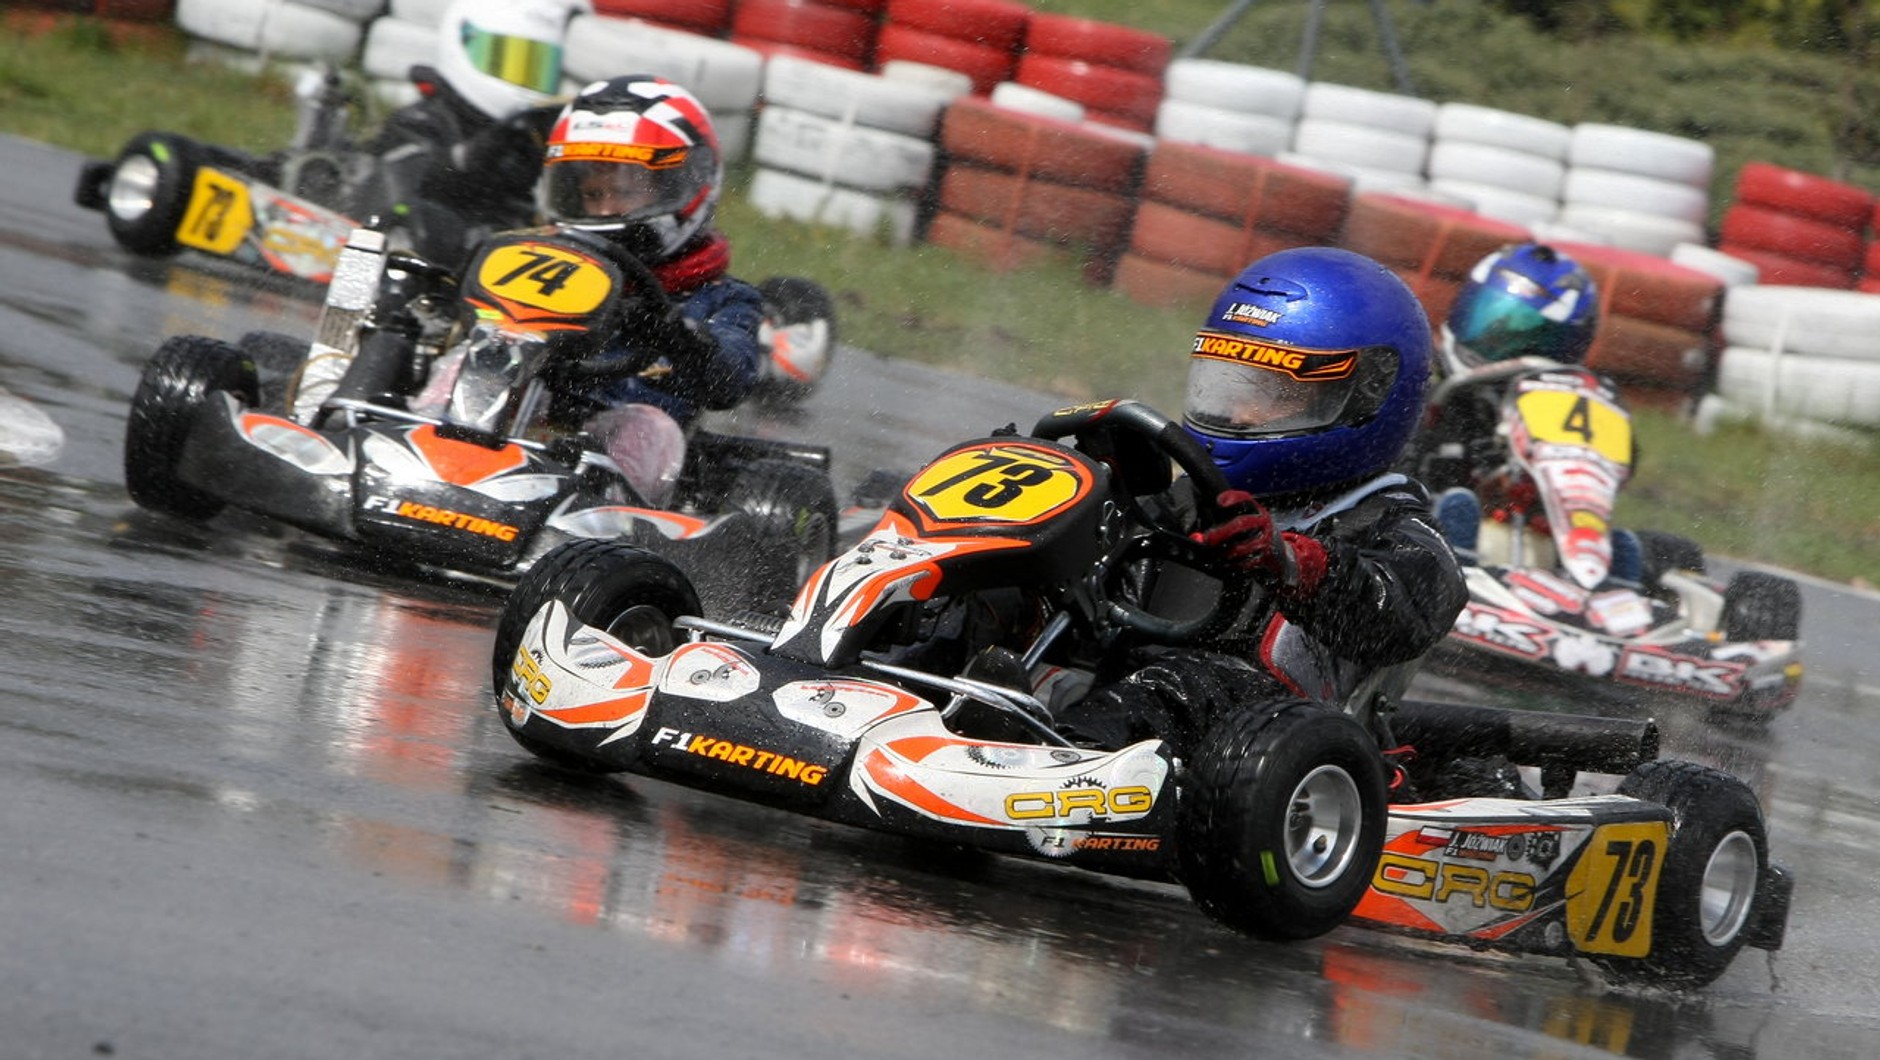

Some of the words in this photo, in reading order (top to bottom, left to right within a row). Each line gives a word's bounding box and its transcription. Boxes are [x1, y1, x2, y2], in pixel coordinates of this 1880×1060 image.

[492, 250, 581, 297] 74
[1562, 395, 1592, 442] 4
[917, 453, 1054, 509] 73
[363, 495, 520, 542] F1KARTING
[651, 726, 828, 786] F1KARTING
[1004, 785, 1153, 821] CRG
[1370, 852, 1537, 913] CRG
[1585, 839, 1656, 944] 73
